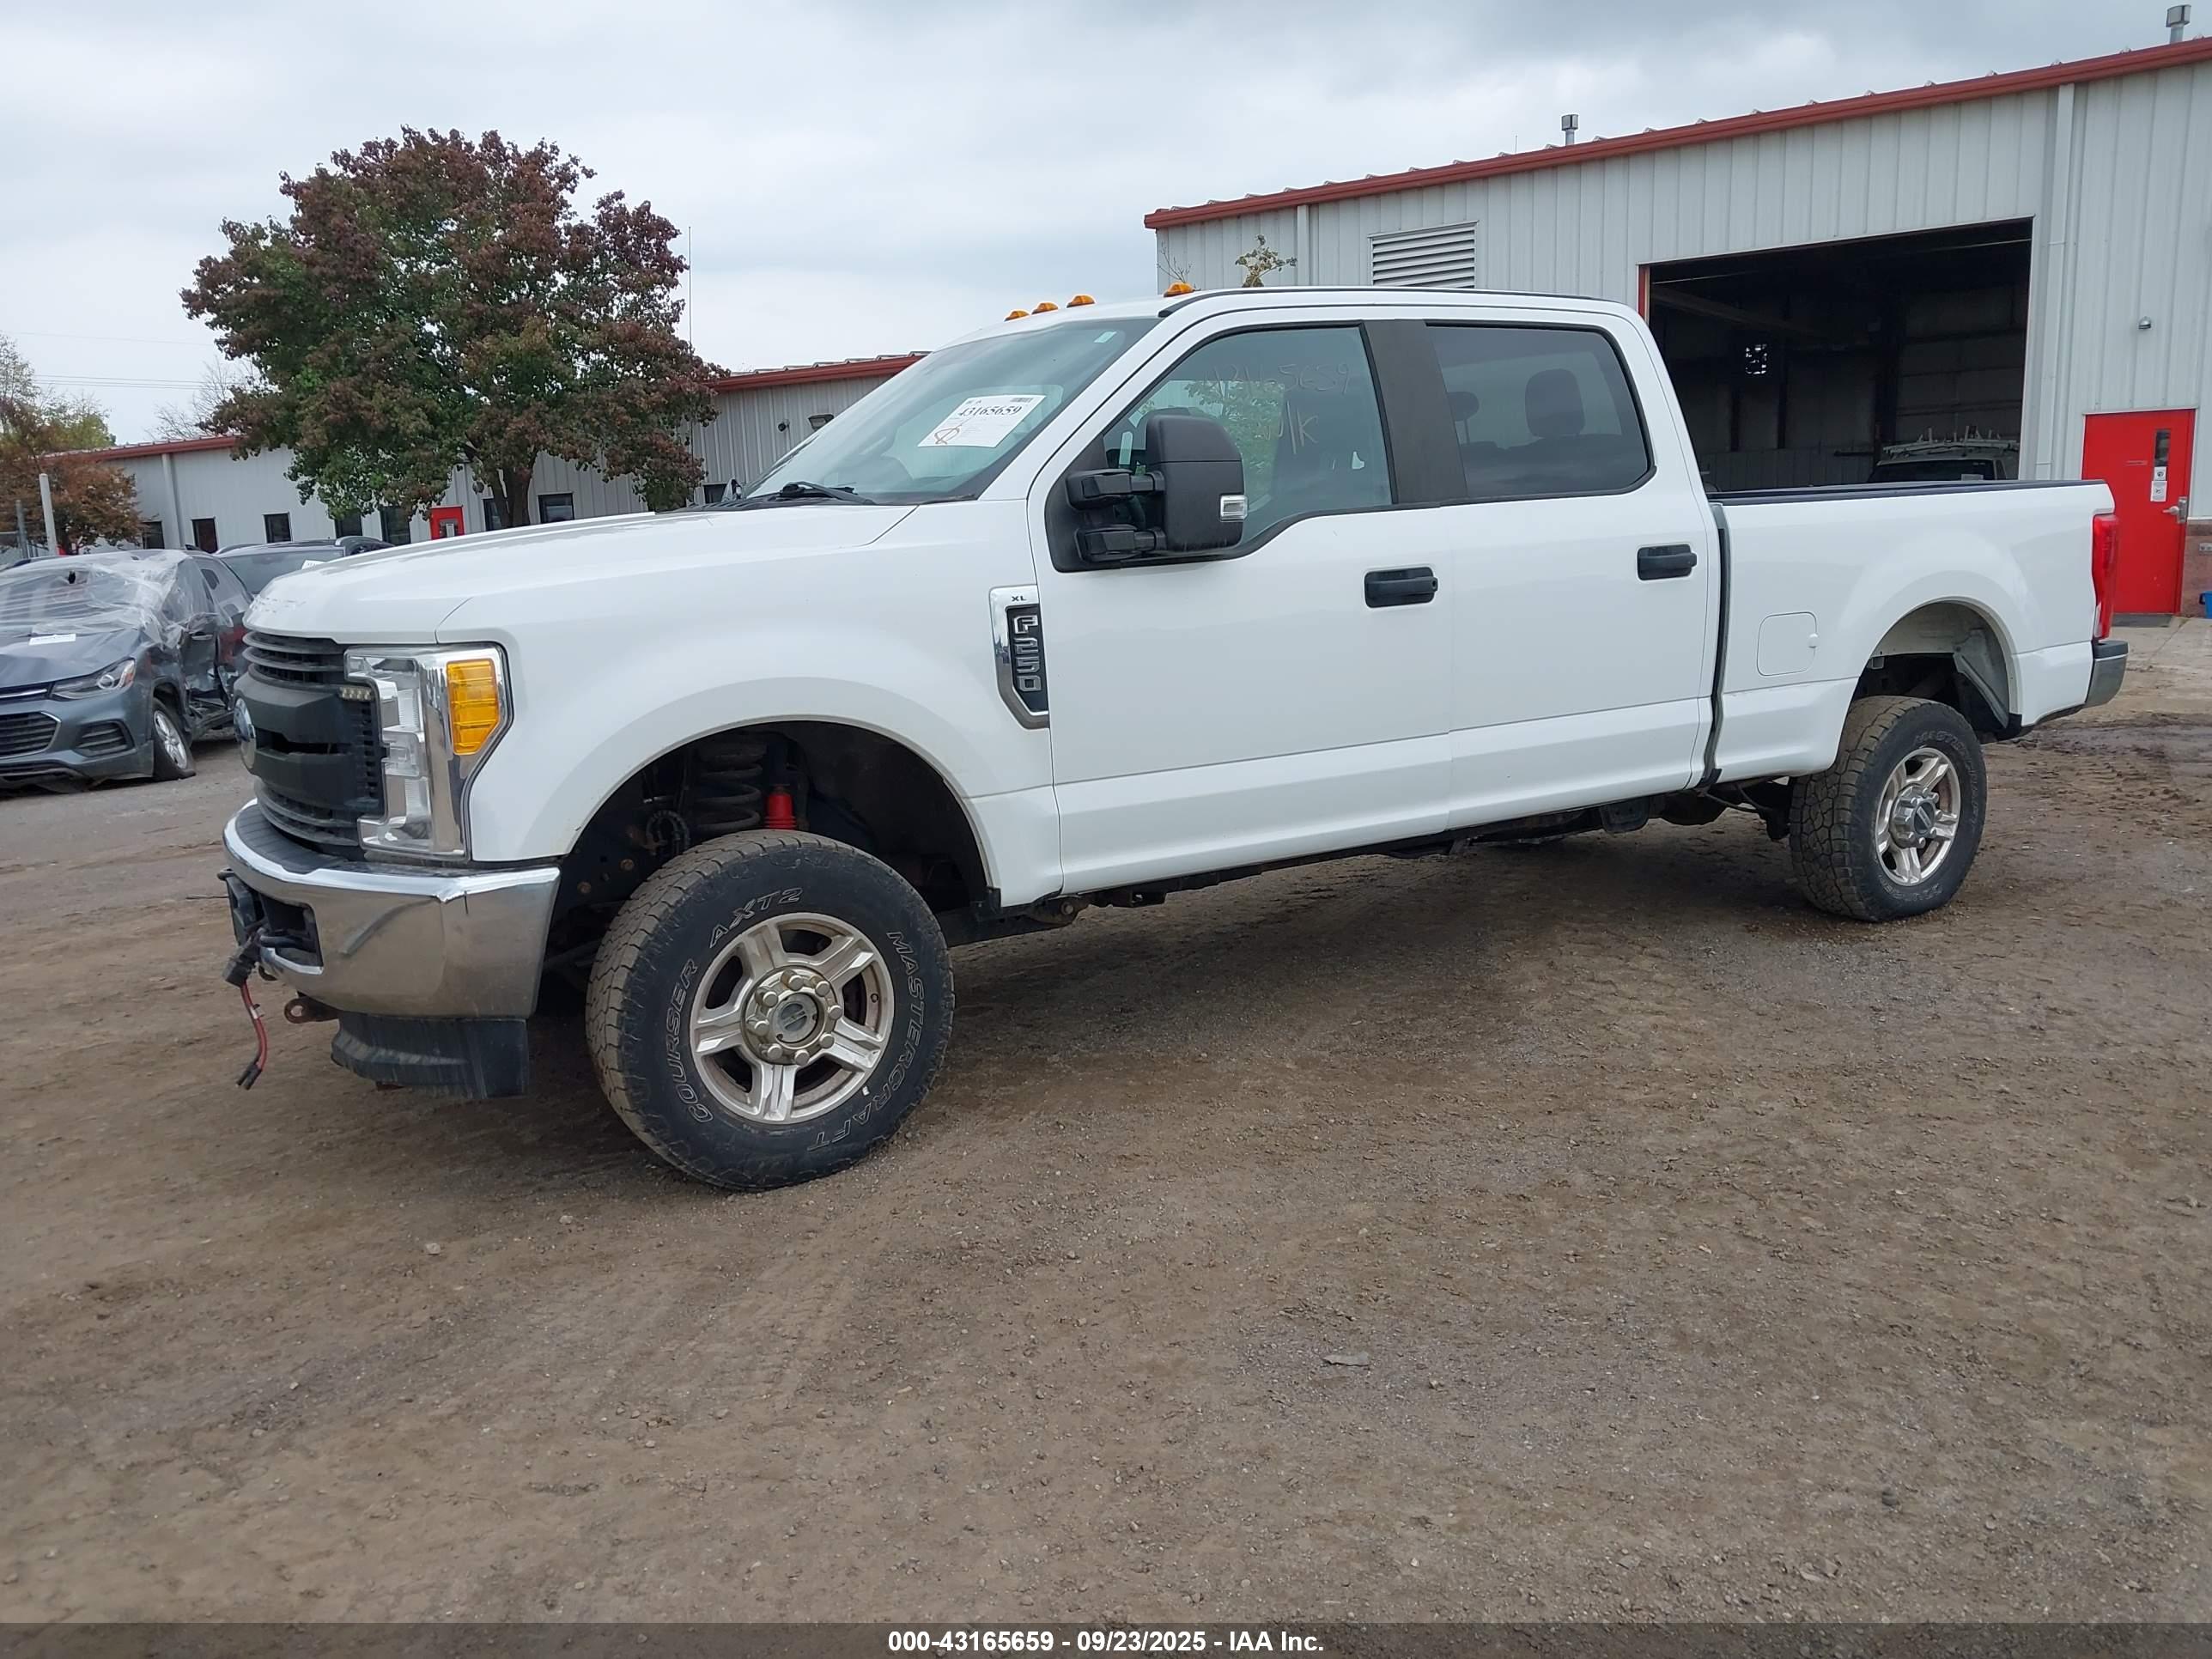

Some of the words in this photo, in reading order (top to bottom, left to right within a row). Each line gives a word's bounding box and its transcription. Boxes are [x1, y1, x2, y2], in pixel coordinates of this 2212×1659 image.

[666, 958, 714, 1122] COURSER
[709, 888, 803, 948] AXT2
[806, 931, 926, 1152] MASTERCRAFT
